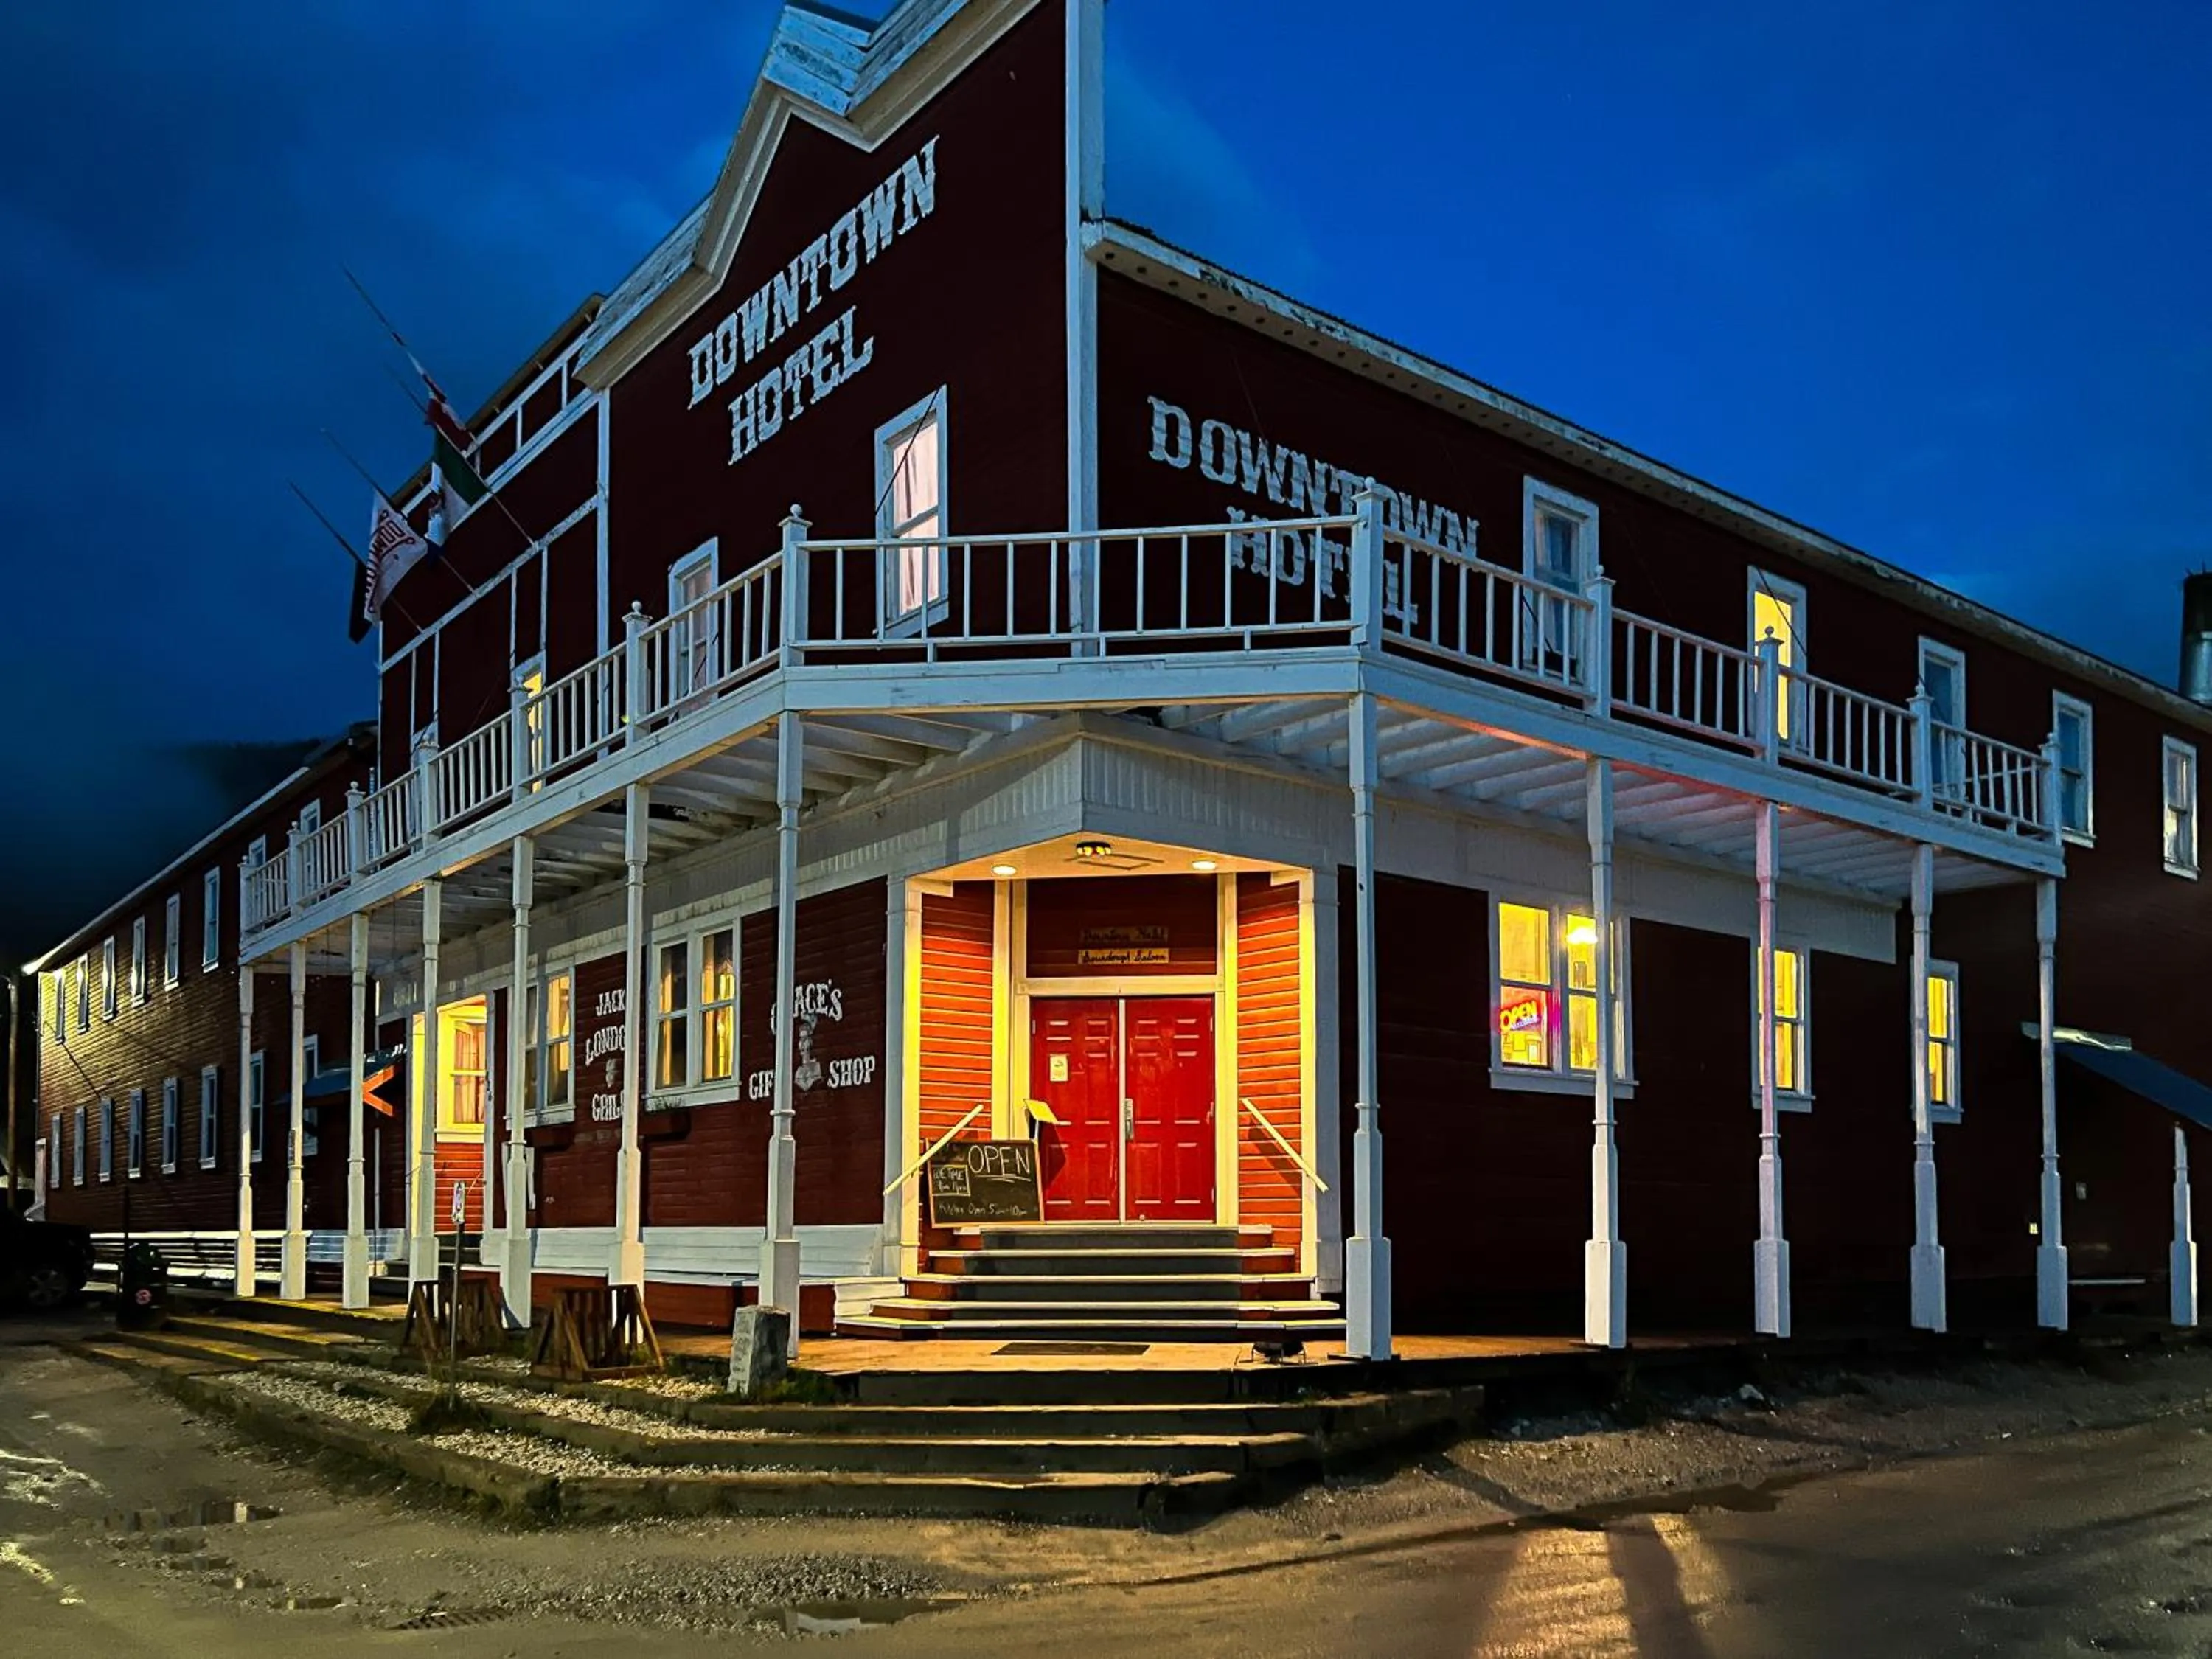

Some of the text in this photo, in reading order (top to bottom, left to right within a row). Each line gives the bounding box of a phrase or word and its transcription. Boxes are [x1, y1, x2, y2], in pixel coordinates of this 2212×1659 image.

[687, 135, 940, 410] DOWNTOWN
[727, 305, 874, 465] HOTEL
[1226, 506, 1419, 625] HOTL
[596, 989, 625, 1016] JACK
[770, 978, 843, 1035] ACE'S
[1500, 1000, 1537, 1032] OPEN
[585, 1024, 626, 1066] LONDO
[748, 1055, 876, 1101] GIF SHOP
[968, 1145, 1030, 1175] OPEN
